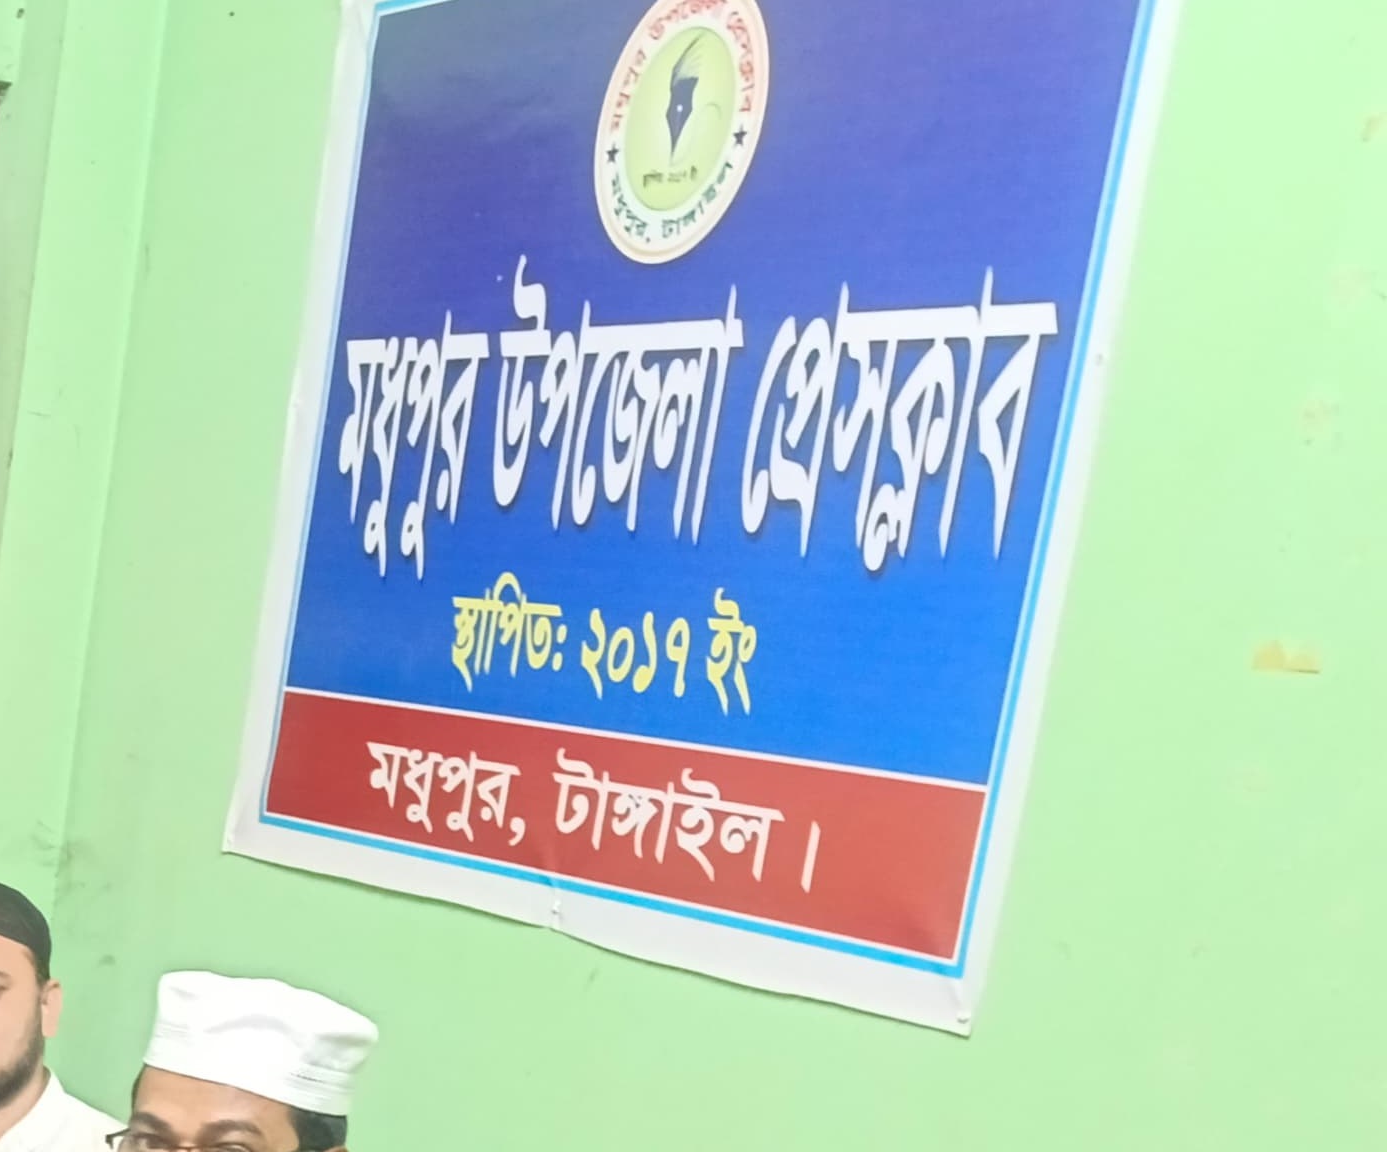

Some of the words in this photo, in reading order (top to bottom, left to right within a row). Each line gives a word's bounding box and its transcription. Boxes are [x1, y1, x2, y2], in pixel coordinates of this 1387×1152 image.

[337, 309, 490, 582] মধুপুর
[488, 253, 745, 546] উপজেলা
[741, 265, 1058, 572] প্রেসক্লাব
[579, 607, 689, 698] ২০১৭
[704, 586, 757, 715] ইং
[365, 739, 530, 847] মধুপুর,
[552, 747, 785, 882] টাঙ্গাইল
